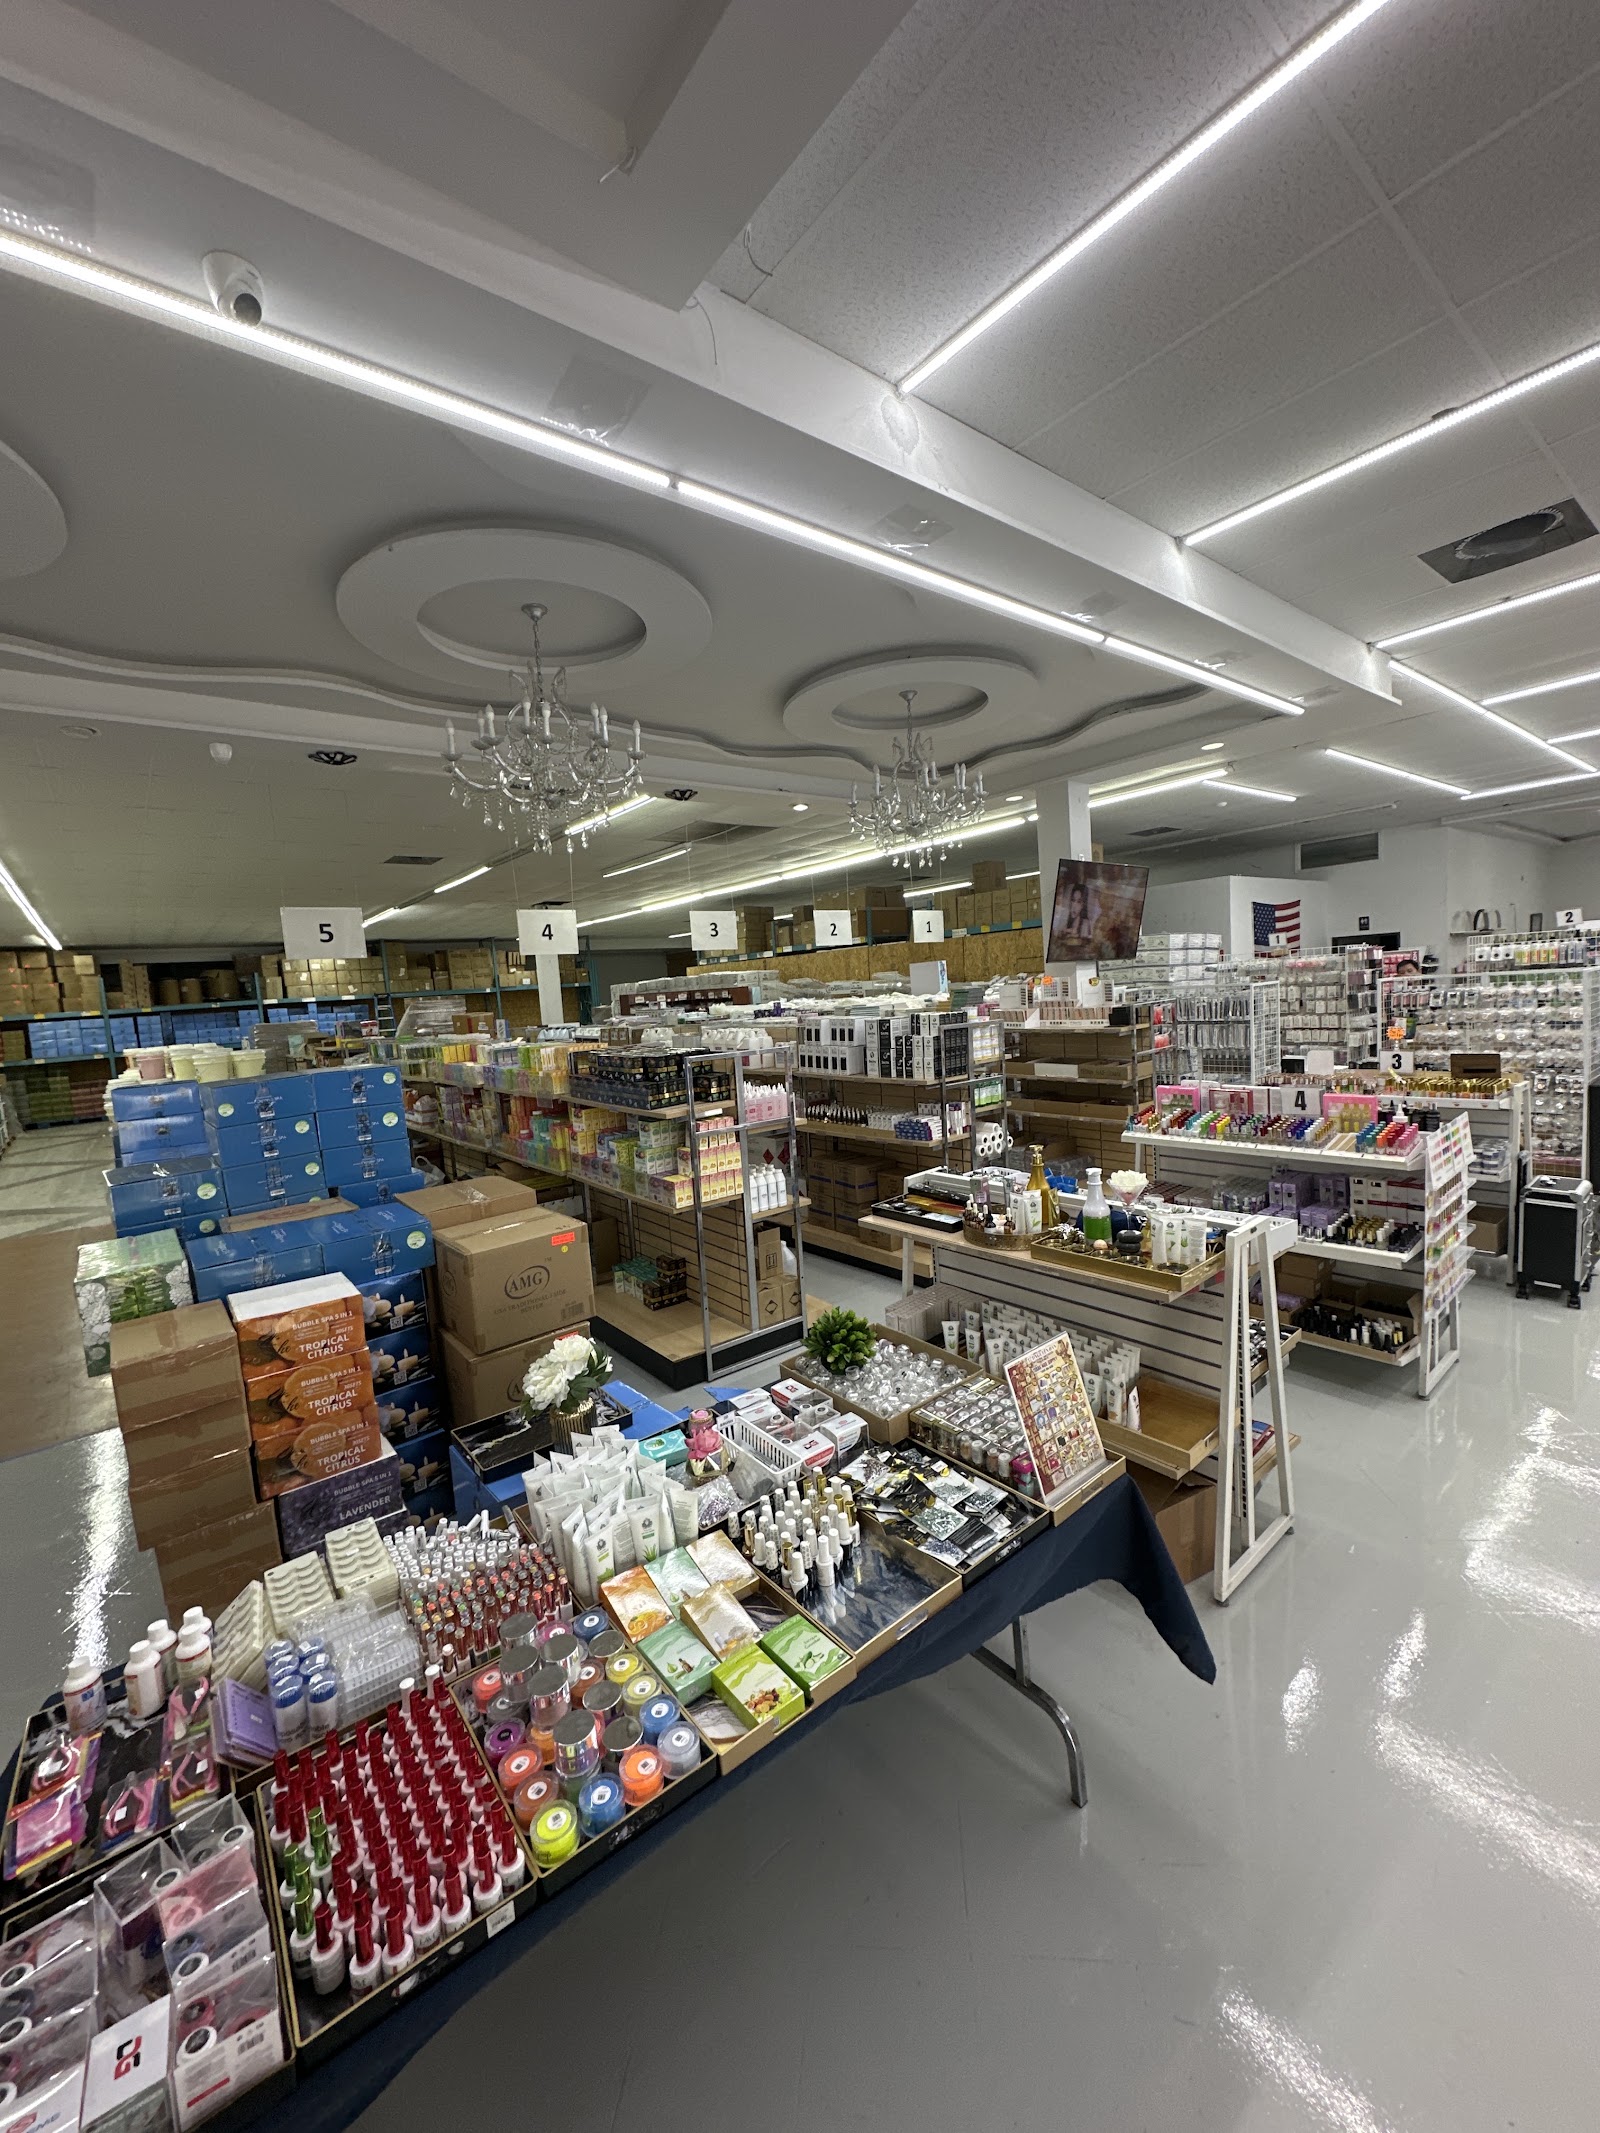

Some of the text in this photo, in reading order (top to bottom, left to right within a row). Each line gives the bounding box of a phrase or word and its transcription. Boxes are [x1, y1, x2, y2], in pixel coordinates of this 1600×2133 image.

[1565, 911, 1574, 923] 2
[318, 923, 334, 943] 5
[541, 923, 554, 941] 4
[709, 922, 719, 937] 3
[830, 922, 838, 936] 2
[926, 920, 933, 933] 1
[1275, 934, 1280, 945] 1
[1391, 1053, 1403, 1070] 3
[1294, 1090, 1307, 1111] 4
[509, 1272, 543, 1294] AMG
[292, 1318, 320, 1330] BUBBLE
[320, 1315, 334, 1323] SPA
[299, 1333, 350, 1353] TROPICAL
[307, 1343, 344, 1360] CITRUS
[300, 1374, 329, 1387] BUBBLE
[329, 1371, 343, 1380] SPA
[308, 1389, 358, 1409] TROPICAL
[316, 1399, 352, 1416] CITRUS
[310, 1431, 337, 1445] BUBBLE
[337, 1426, 351, 1436] SPA
[356, 1422, 364, 1430] IN
[317, 1444, 367, 1467] TROPICAL
[325, 1454, 361, 1473] CITRUS
[333, 1482, 361, 1497] BUBBLE
[361, 1477, 374, 1487] SPA
[379, 1472, 387, 1480] IN
[339, 1495, 391, 1521] LAVENDER
